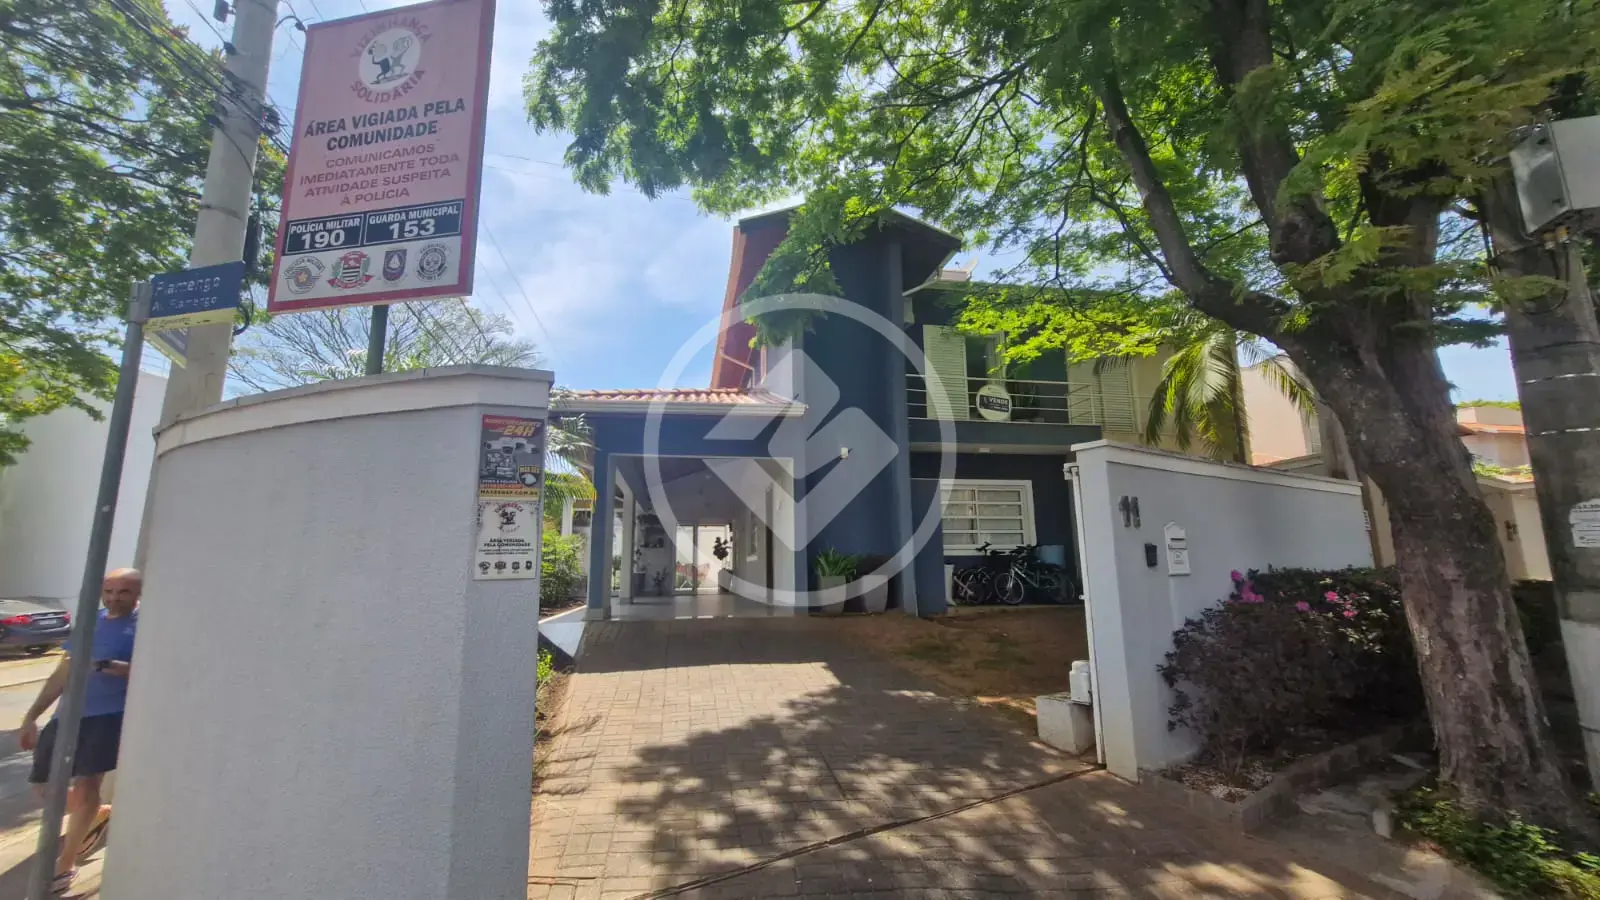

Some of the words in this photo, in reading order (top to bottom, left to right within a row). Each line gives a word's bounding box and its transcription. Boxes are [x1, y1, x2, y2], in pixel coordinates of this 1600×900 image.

[304, 118, 346, 138] ÁREA
[352, 106, 417, 130] VIGIADA
[423, 98, 466, 117] PELA
[326, 120, 438, 151] COMUNIDADE
[300, 161, 415, 186] IMEDIATAMENTE
[420, 153, 460, 167] TODA
[326, 144, 435, 169] COMUNICAMOS
[304, 178, 378, 198] ATIVIDADE
[382, 168, 451, 186] SUSPEITA
[325, 217, 360, 229] MILITAR
[369, 212, 406, 225] GUARDA
[408, 206, 458, 219] MUNICIPAL
[301, 229, 345, 249] 190
[389, 218, 436, 239] 153
[154, 276, 221, 296] Famengo
[503, 424, 535, 437] 24H
